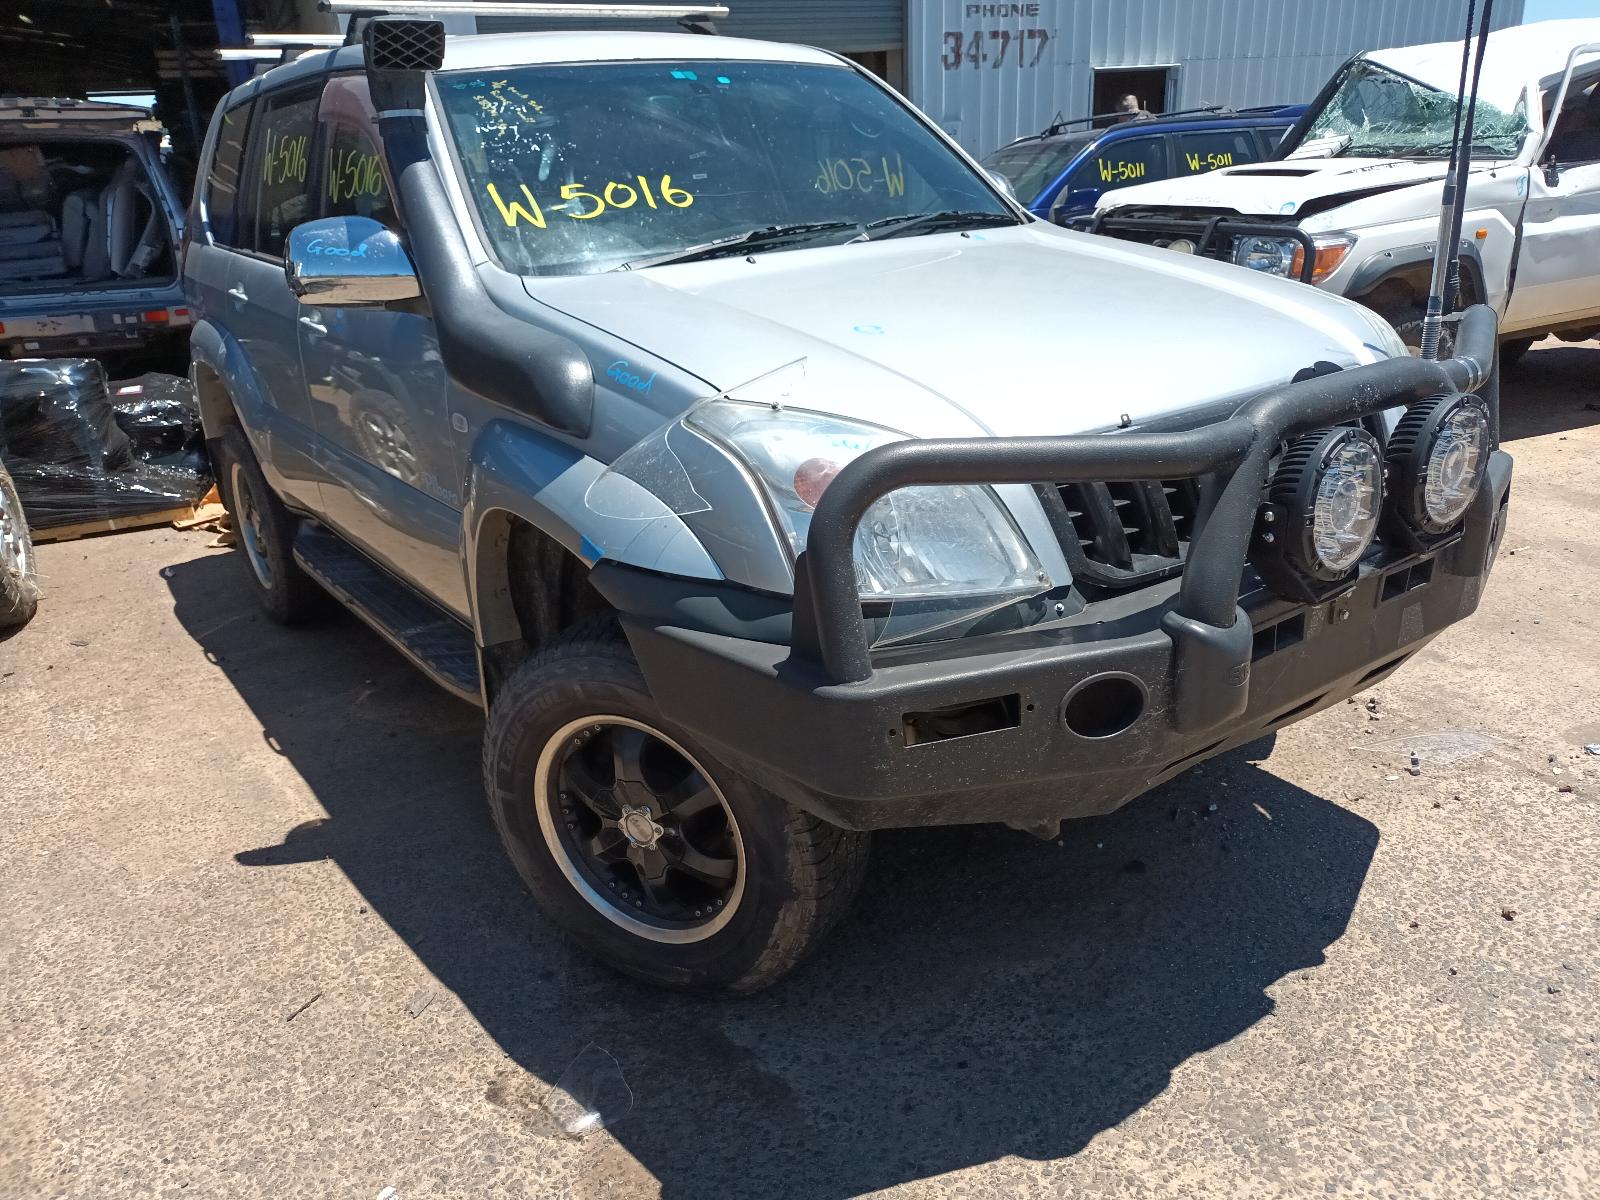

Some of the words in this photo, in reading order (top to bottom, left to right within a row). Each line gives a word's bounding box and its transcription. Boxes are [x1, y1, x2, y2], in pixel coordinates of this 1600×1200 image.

[966, 3, 1040, 18] PHONE
[941, 28, 1049, 71] 34717
[264, 127, 307, 186] W-5016
[1098, 158, 1145, 182] W-5011
[1185, 152, 1233, 171] W-5011
[329, 147, 382, 204] W-5016
[486, 174, 694, 229] W-5016
[306, 239, 368, 258] Good
[607, 360, 657, 394] Good
